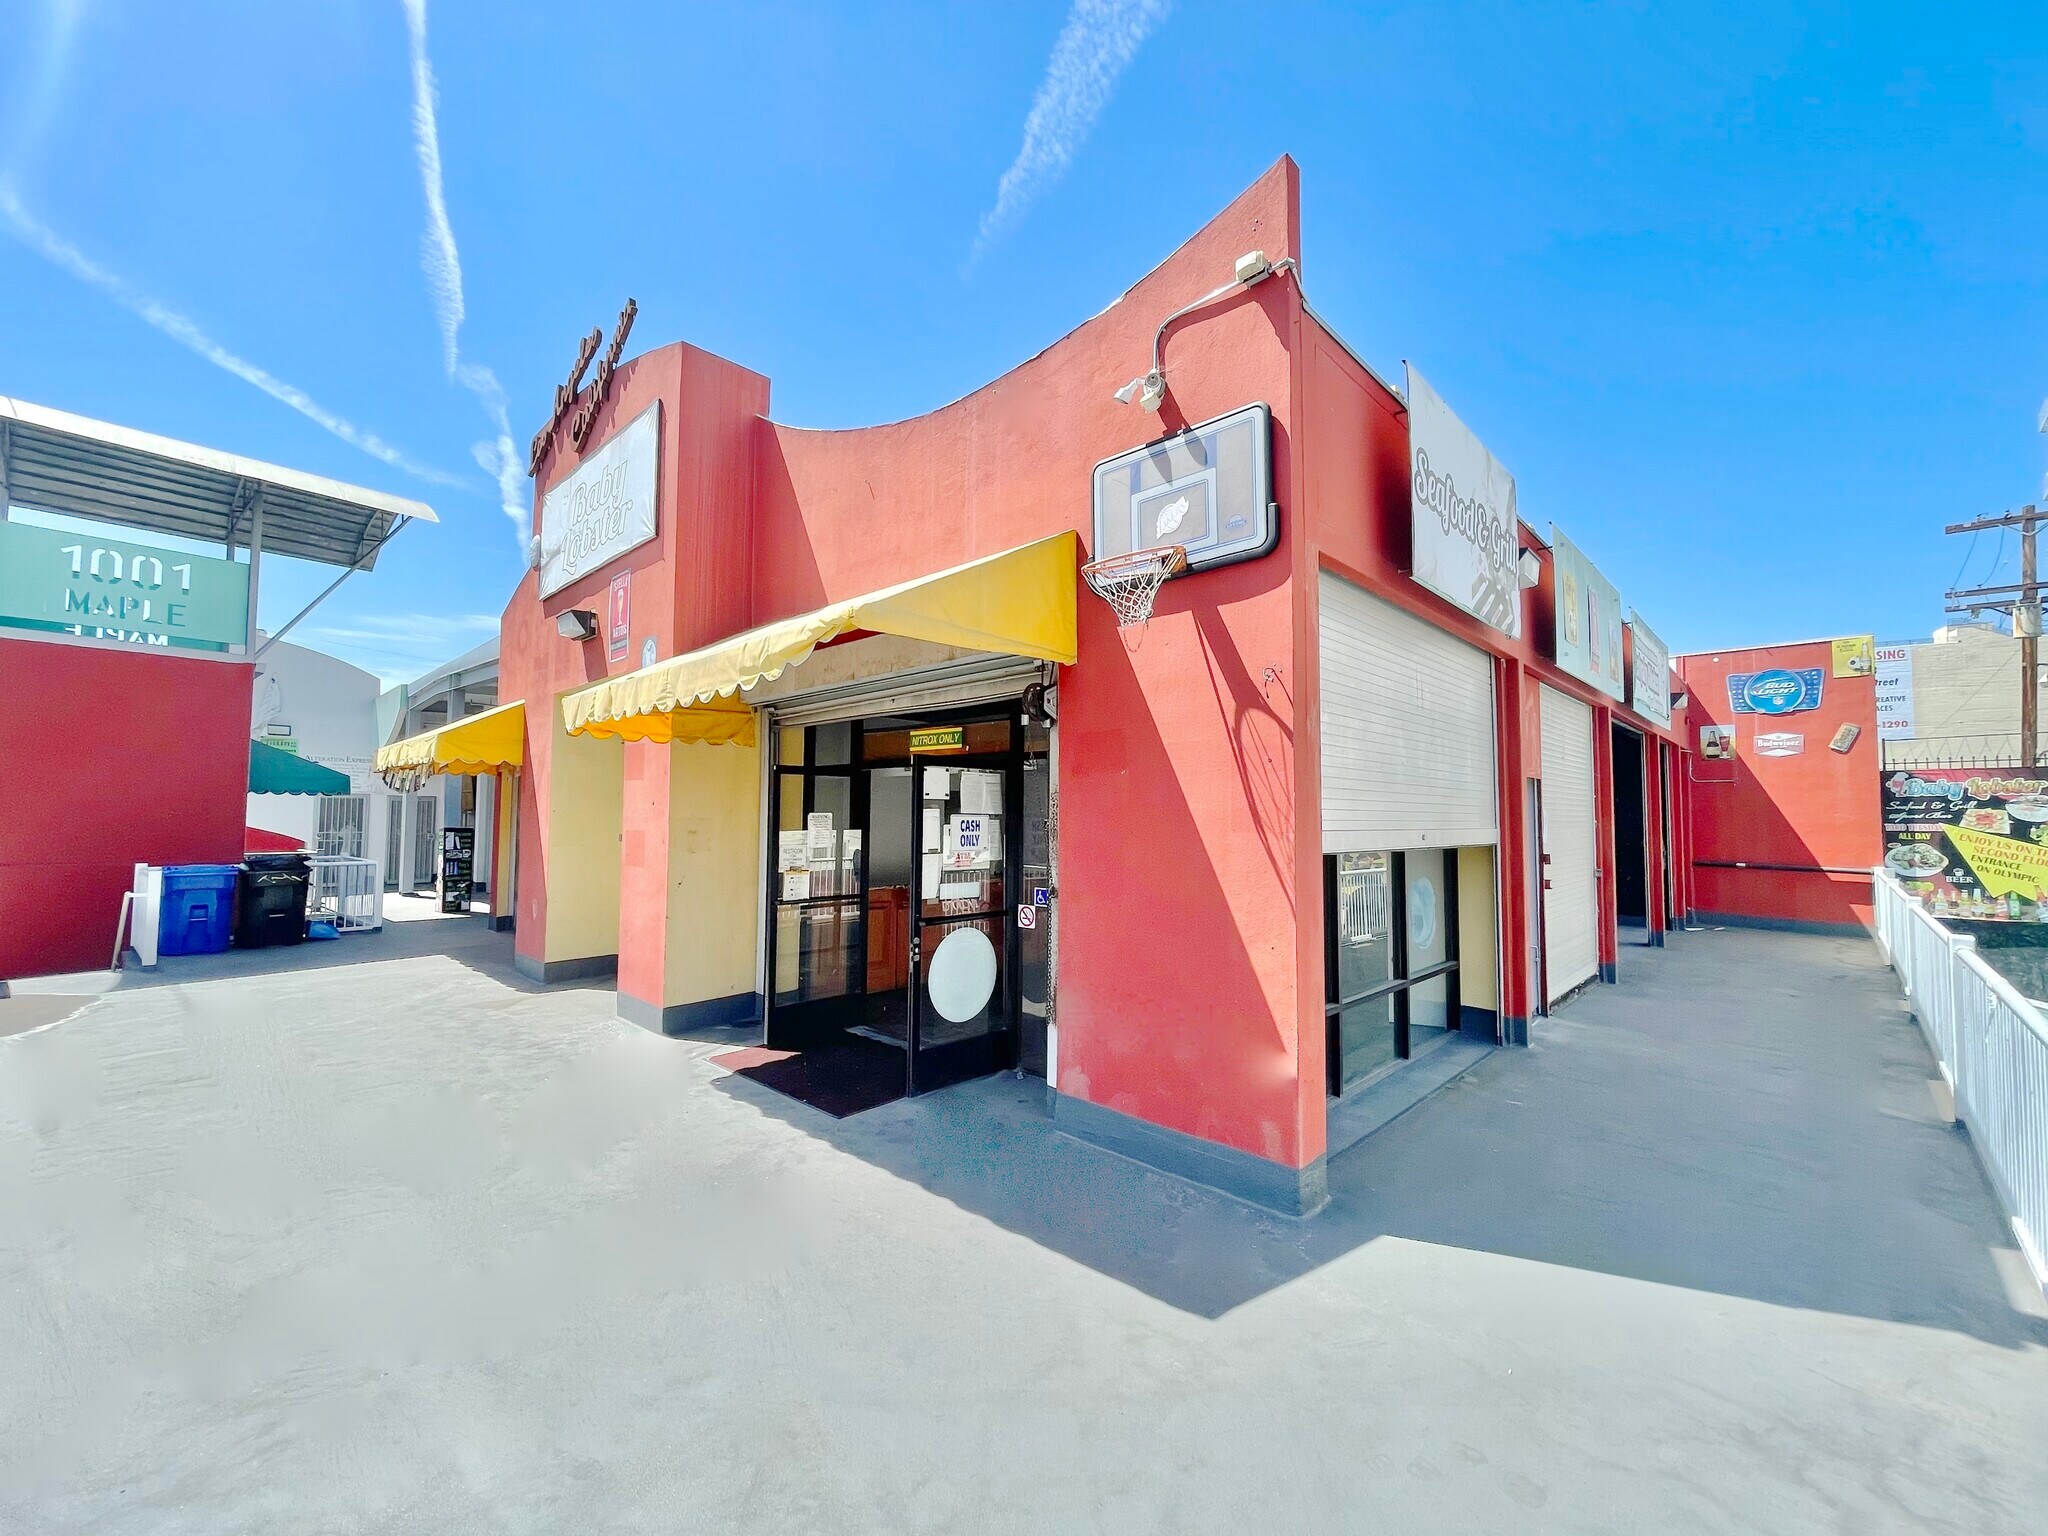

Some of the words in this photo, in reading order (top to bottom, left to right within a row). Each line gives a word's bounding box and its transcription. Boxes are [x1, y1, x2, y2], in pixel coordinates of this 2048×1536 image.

[572, 460, 628, 527] Baby
[1414, 447, 1476, 544] Seafood
[1476, 503, 1489, 552] &
[1491, 517, 1517, 576] Grill
[562, 499, 633, 575] Lobster
[60, 544, 192, 596] 1001
[64, 588, 187, 627] MAPLE
[912, 735, 938, 746] NITROX
[939, 733, 960, 744] ONLY
[1906, 778, 1965, 800] Baby
[1966, 777, 2048, 800] Lobster
[1949, 801, 1978, 812] Grill
[960, 820, 981, 832] CASH
[960, 834, 980, 847] ONLY
[1959, 834, 1994, 847] ENJOY
[1997, 841, 2012, 850] US
[2015, 844, 2033, 854] ON
[1970, 854, 2023, 871] ENTRANCE
[1973, 846, 2019, 861] SECOND
[1976, 864, 1991, 874] ON
[1993, 868, 2040, 884] OLYMPIC
